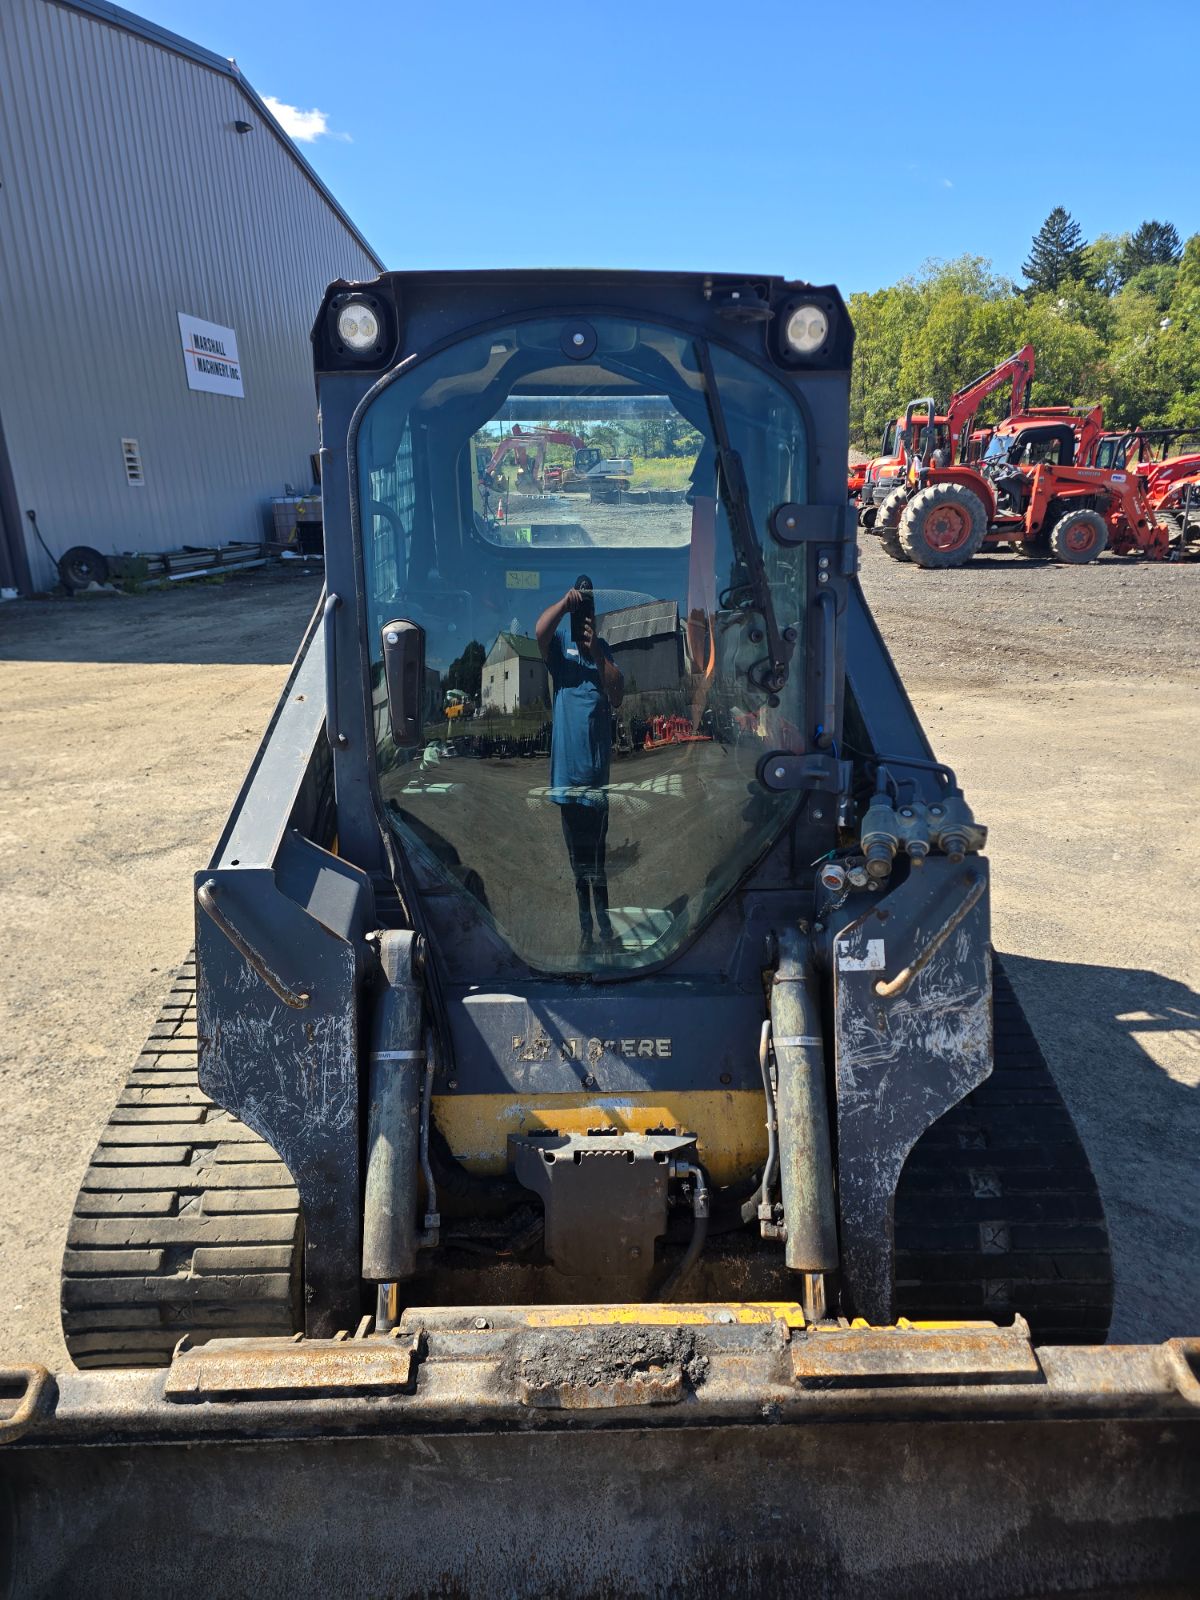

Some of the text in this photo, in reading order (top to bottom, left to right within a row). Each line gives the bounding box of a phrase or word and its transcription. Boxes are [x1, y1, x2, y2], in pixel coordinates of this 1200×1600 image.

[193, 333, 226, 356] MARSHALL
[197, 357, 229, 378] MACHINERY
[588, 1037, 672, 1060] ERE
